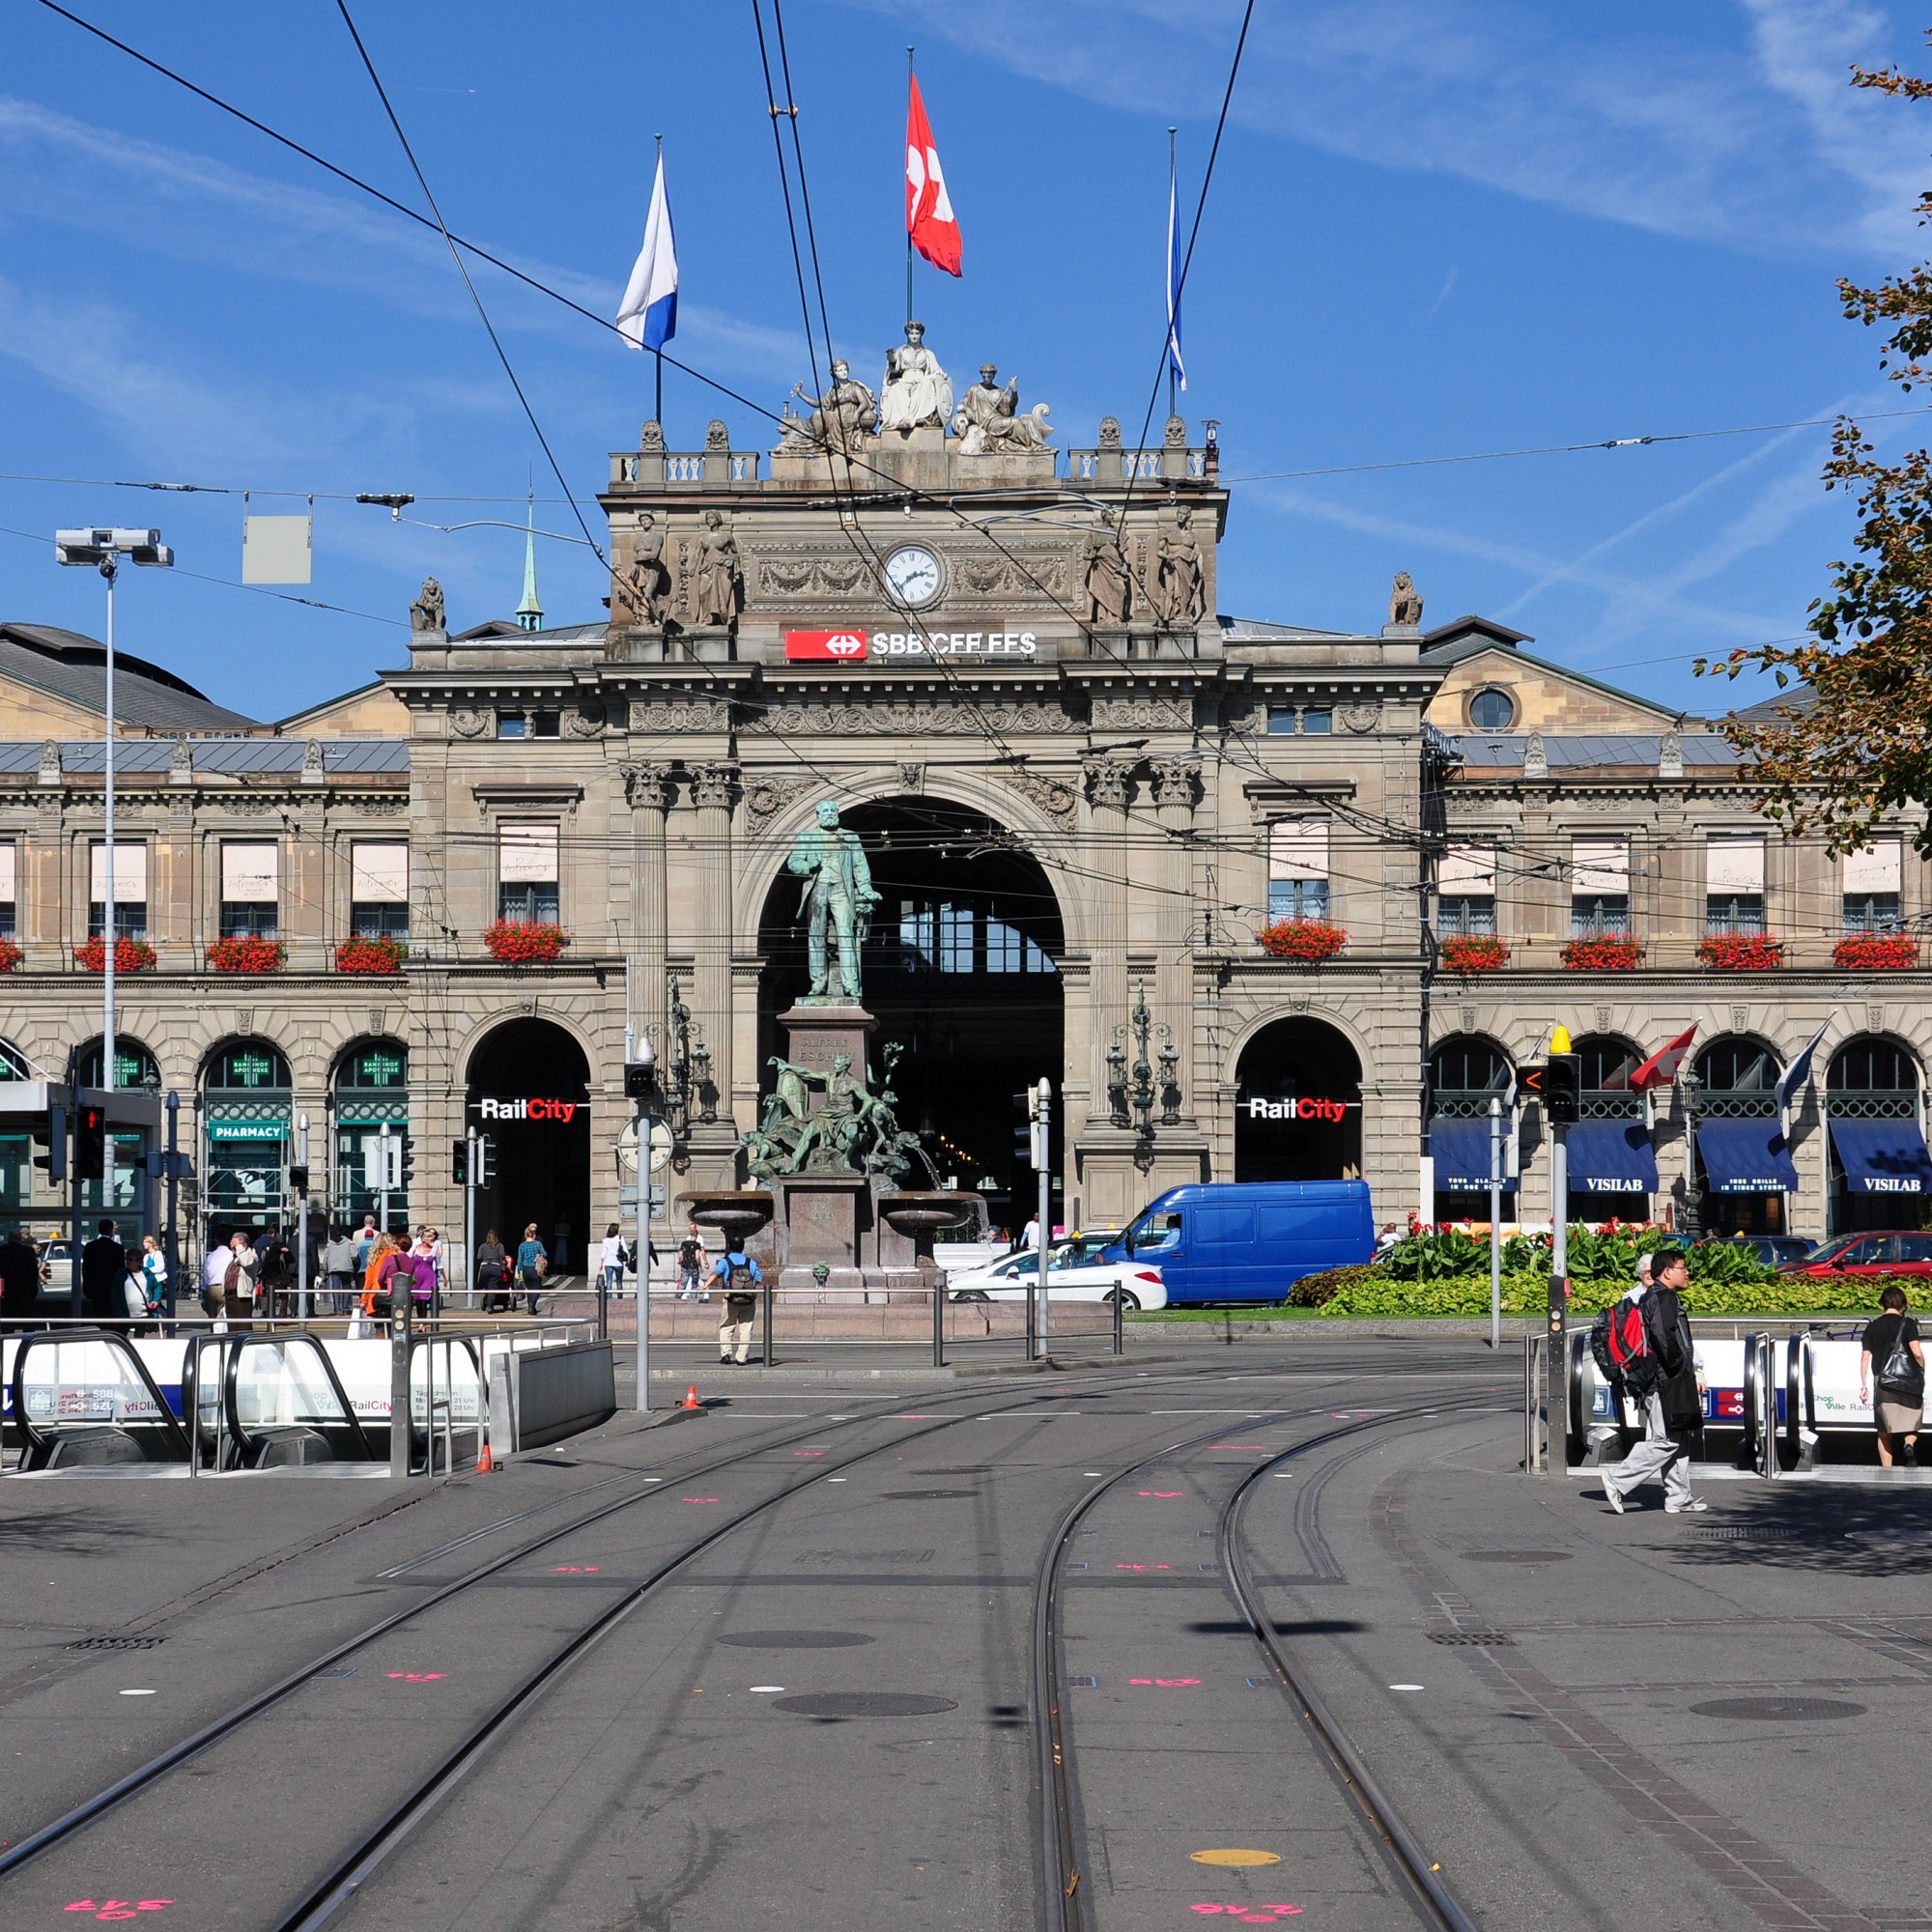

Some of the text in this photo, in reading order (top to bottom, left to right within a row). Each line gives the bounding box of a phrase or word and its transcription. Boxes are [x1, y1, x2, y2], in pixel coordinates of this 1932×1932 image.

[872, 633, 1037, 655] SBB CFF FFS
[803, 1037, 850, 1047] ALFRED
[481, 1098, 577, 1122] RailCity
[1250, 1097, 1347, 1122] RailCity
[216, 1127, 280, 1137] PHARMACY
[1586, 1179, 1642, 1191] VISILAB
[1863, 1179, 1920, 1191] VISILAB
[92, 1389, 114, 1399] SBB
[92, 1401, 114, 1411] SZU
